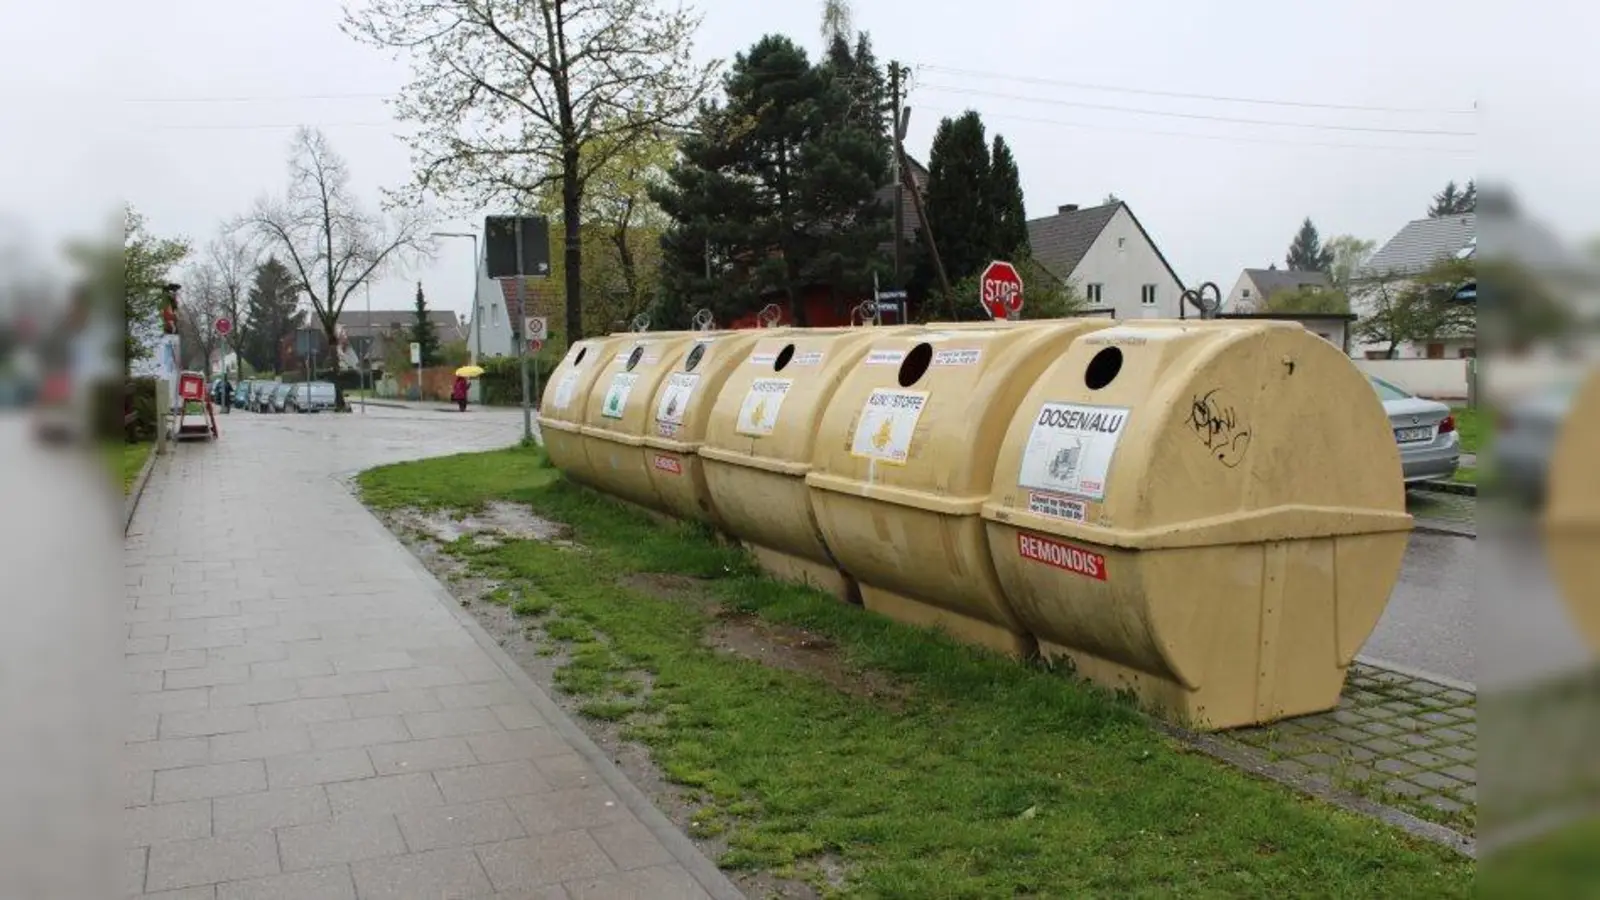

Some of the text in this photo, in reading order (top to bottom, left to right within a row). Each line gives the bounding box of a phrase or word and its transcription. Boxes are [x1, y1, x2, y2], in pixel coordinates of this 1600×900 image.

[984, 279, 1019, 304] STOP
[1038, 408, 1123, 433] DOSEN/ALU
[1019, 534, 1099, 576] REMONDIS
